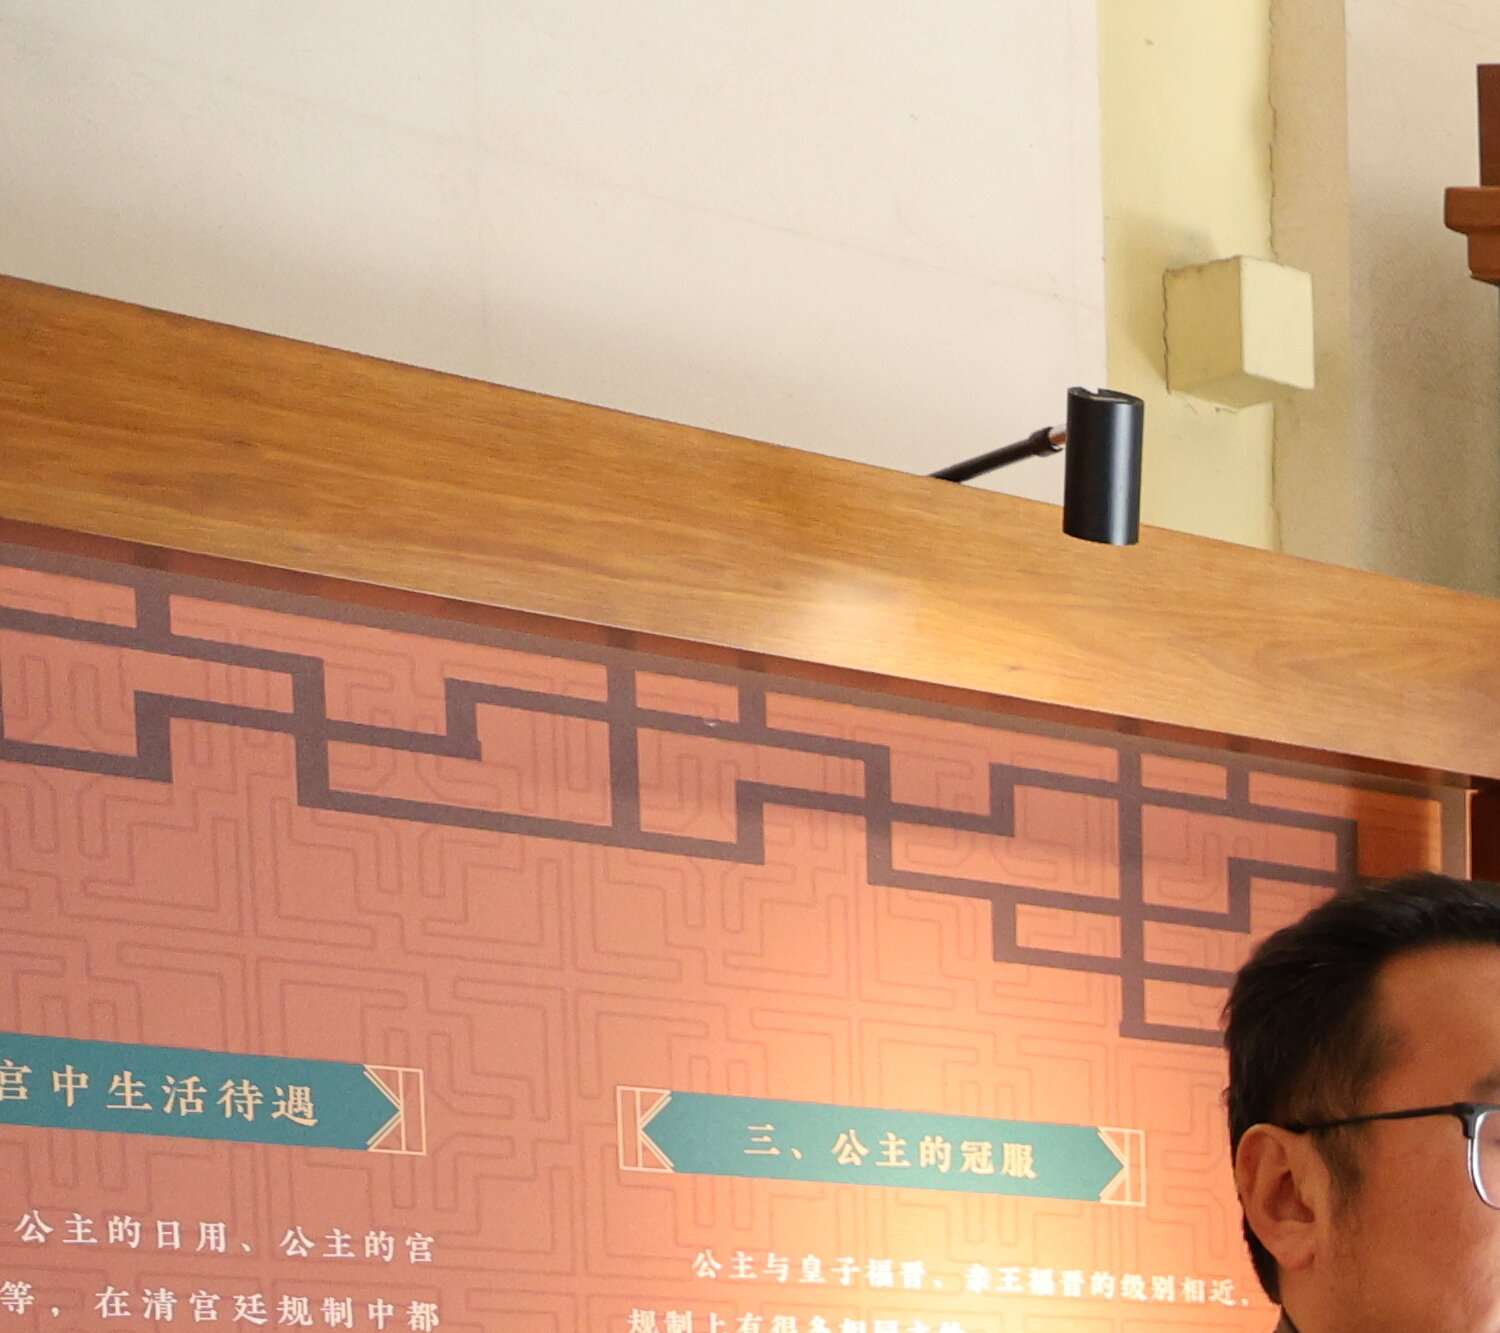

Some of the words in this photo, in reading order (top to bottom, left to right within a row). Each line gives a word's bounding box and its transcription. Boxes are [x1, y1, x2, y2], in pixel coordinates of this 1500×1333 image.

[743, 1124, 1038, 1180] 三、公主的冠服
[15, 1210, 435, 1264] 公主的日用、公主的宫
[692, 1249, 1250, 1307] 公主与皇子福晋、亲王福晋的级别相近，
[0, 1280, 440, 1333] 等，在清宫廷规制中都
